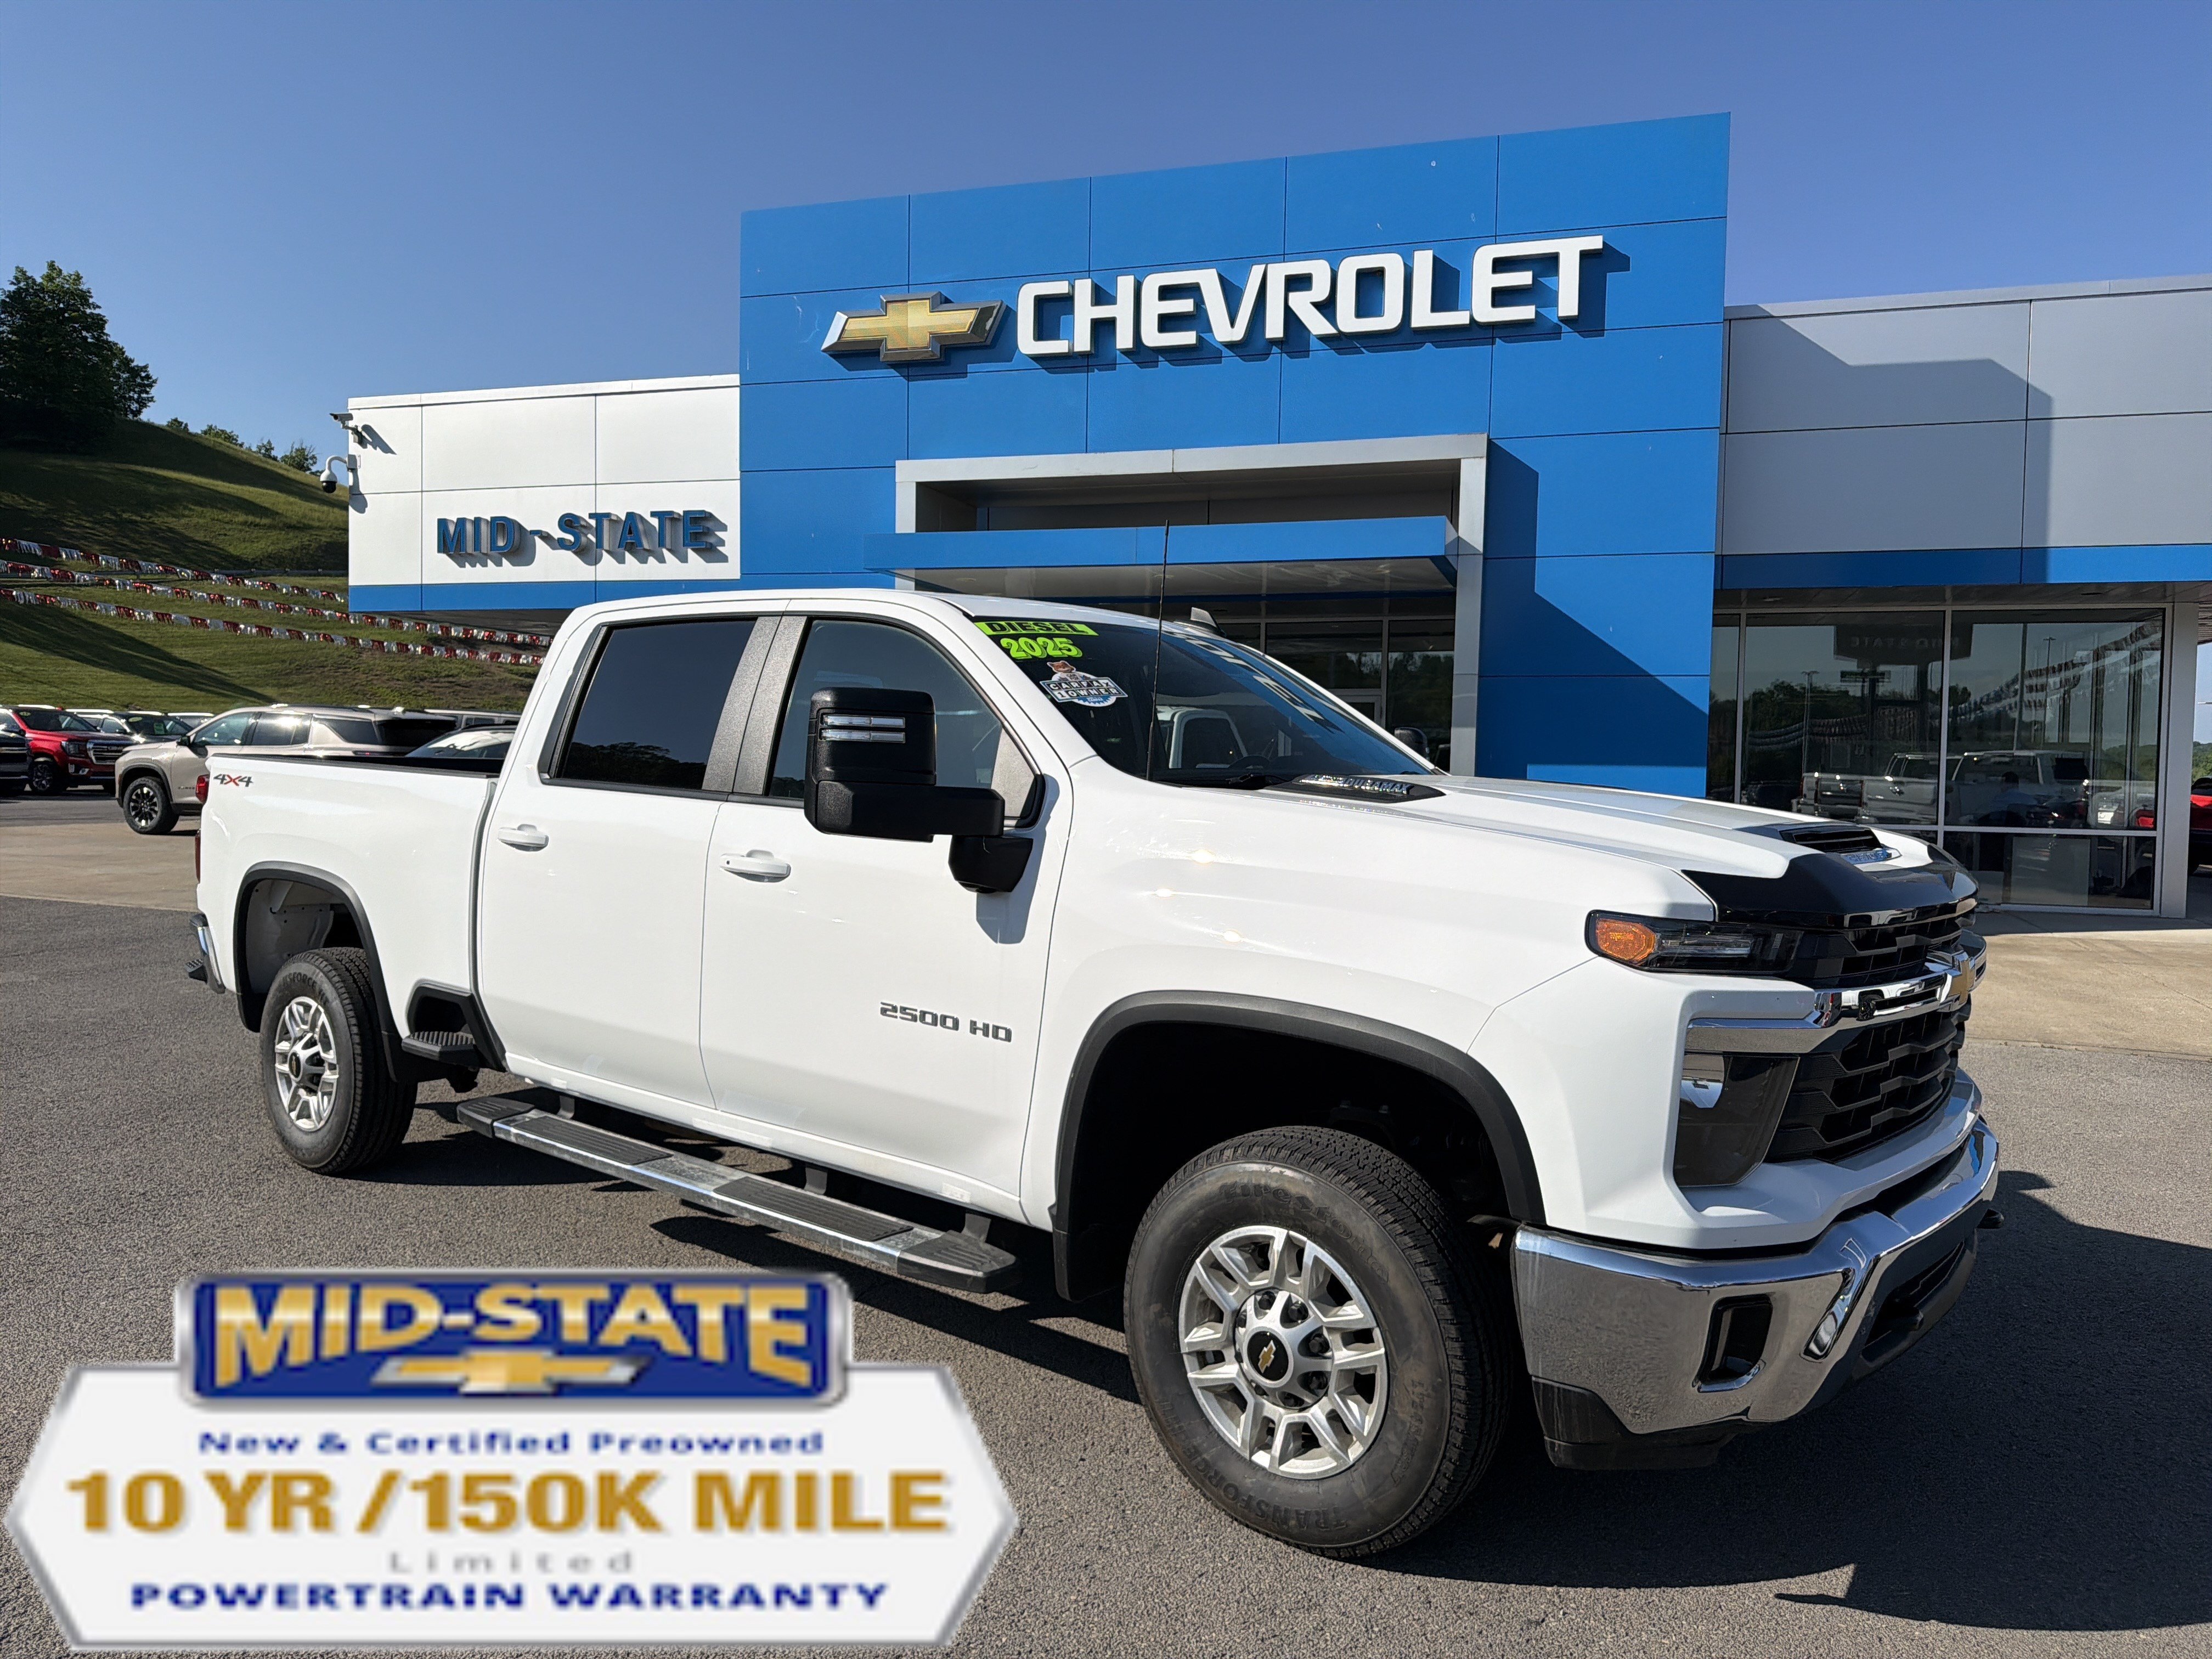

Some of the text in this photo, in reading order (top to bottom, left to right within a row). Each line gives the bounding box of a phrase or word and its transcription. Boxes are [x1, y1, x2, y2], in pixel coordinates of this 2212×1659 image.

[1016, 234, 1604, 357] CHEVROLET
[437, 510, 711, 554] MID-STATE
[985, 622, 1088, 634] DIESEL
[1000, 637, 1082, 659] 2025
[1049, 680, 1112, 690] CARFAX
[1068, 687, 1119, 697] OWNER
[880, 1001, 1012, 1043] 2500 HD
